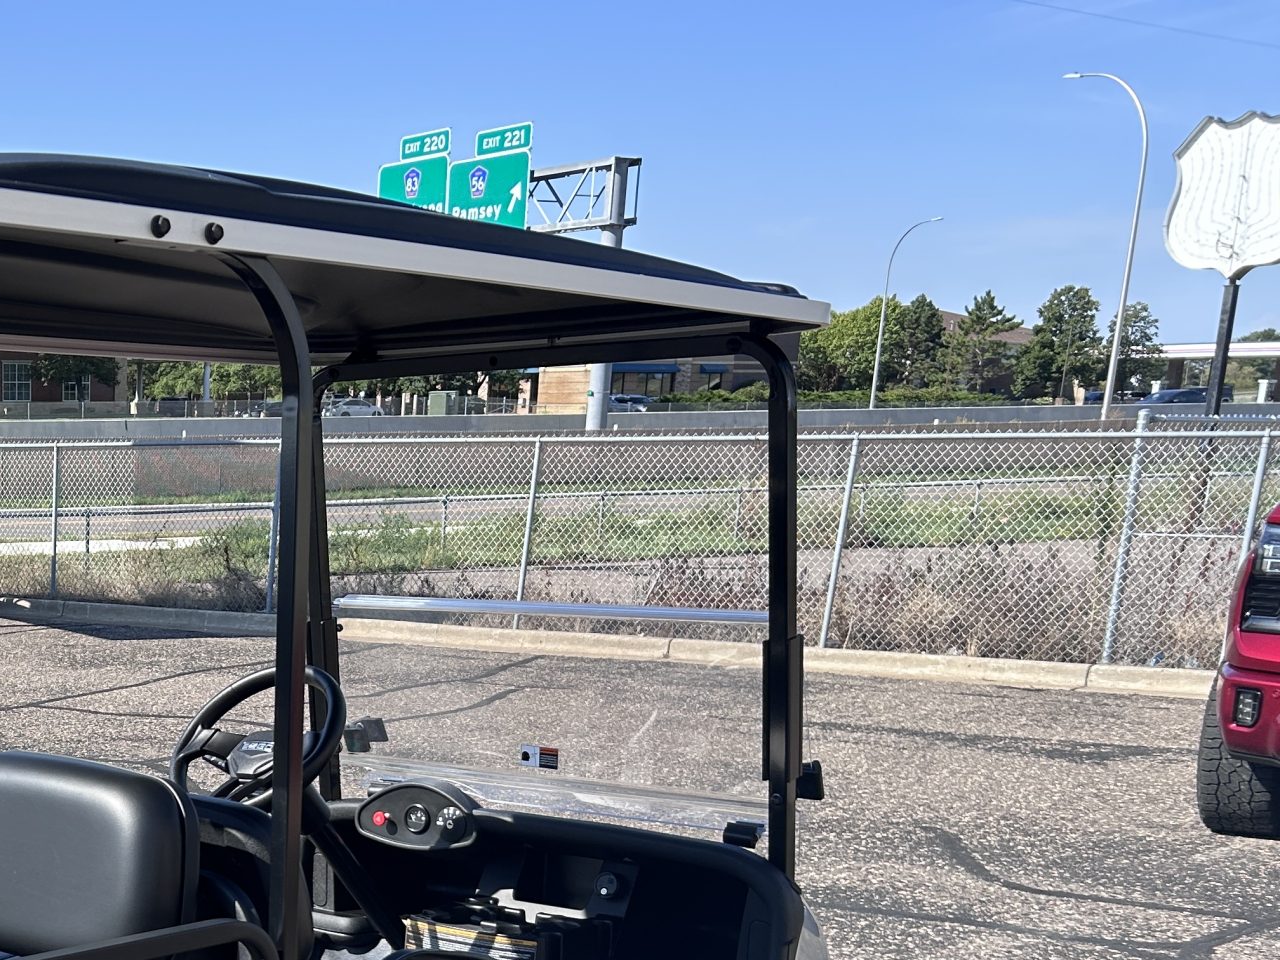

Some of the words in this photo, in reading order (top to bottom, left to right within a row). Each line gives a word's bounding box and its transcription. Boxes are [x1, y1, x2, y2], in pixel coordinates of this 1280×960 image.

[404, 141, 421, 154] EXIT
[423, 134, 446, 153] 220
[482, 135, 501, 150] EXIT
[503, 129, 525, 148] 221
[406, 176, 418, 191] 83
[471, 176, 484, 192] 56
[451, 203, 502, 221] Ramsey
